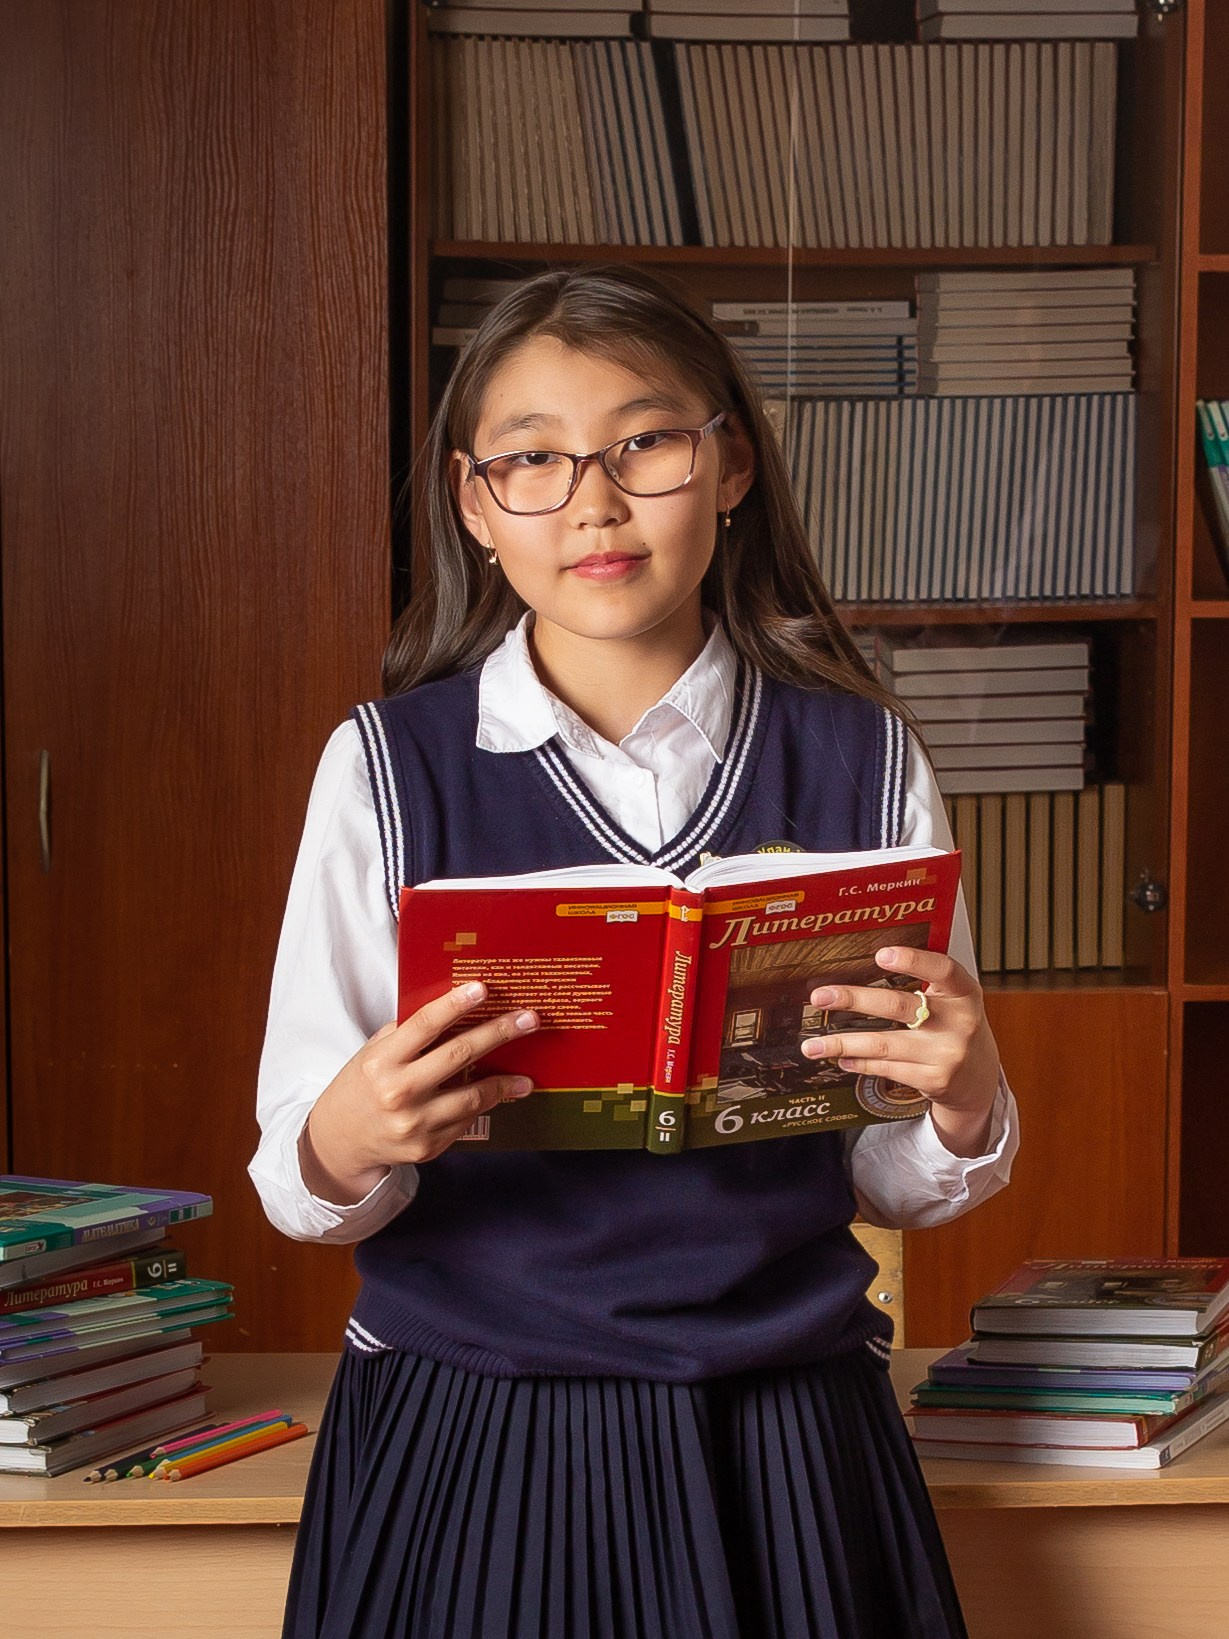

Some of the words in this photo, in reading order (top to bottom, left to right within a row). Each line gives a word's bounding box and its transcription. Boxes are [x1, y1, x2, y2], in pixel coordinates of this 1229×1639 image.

[838, 885, 862, 897] Г.С.
[866, 878, 921, 893] Меркин
[709, 897, 935, 949] Литература
[663, 951, 692, 1045] Литература
[788, 1096, 816, 1105] ЧАСТЬ
[659, 1110, 676, 1126] 6
[714, 1104, 744, 1135] 6
[750, 1101, 831, 1125] класс
[81, 1218, 140, 1243] МАТЕМАТИКА
[4, 1278, 88, 1308] Литература
[147, 1262, 163, 1278] 6
